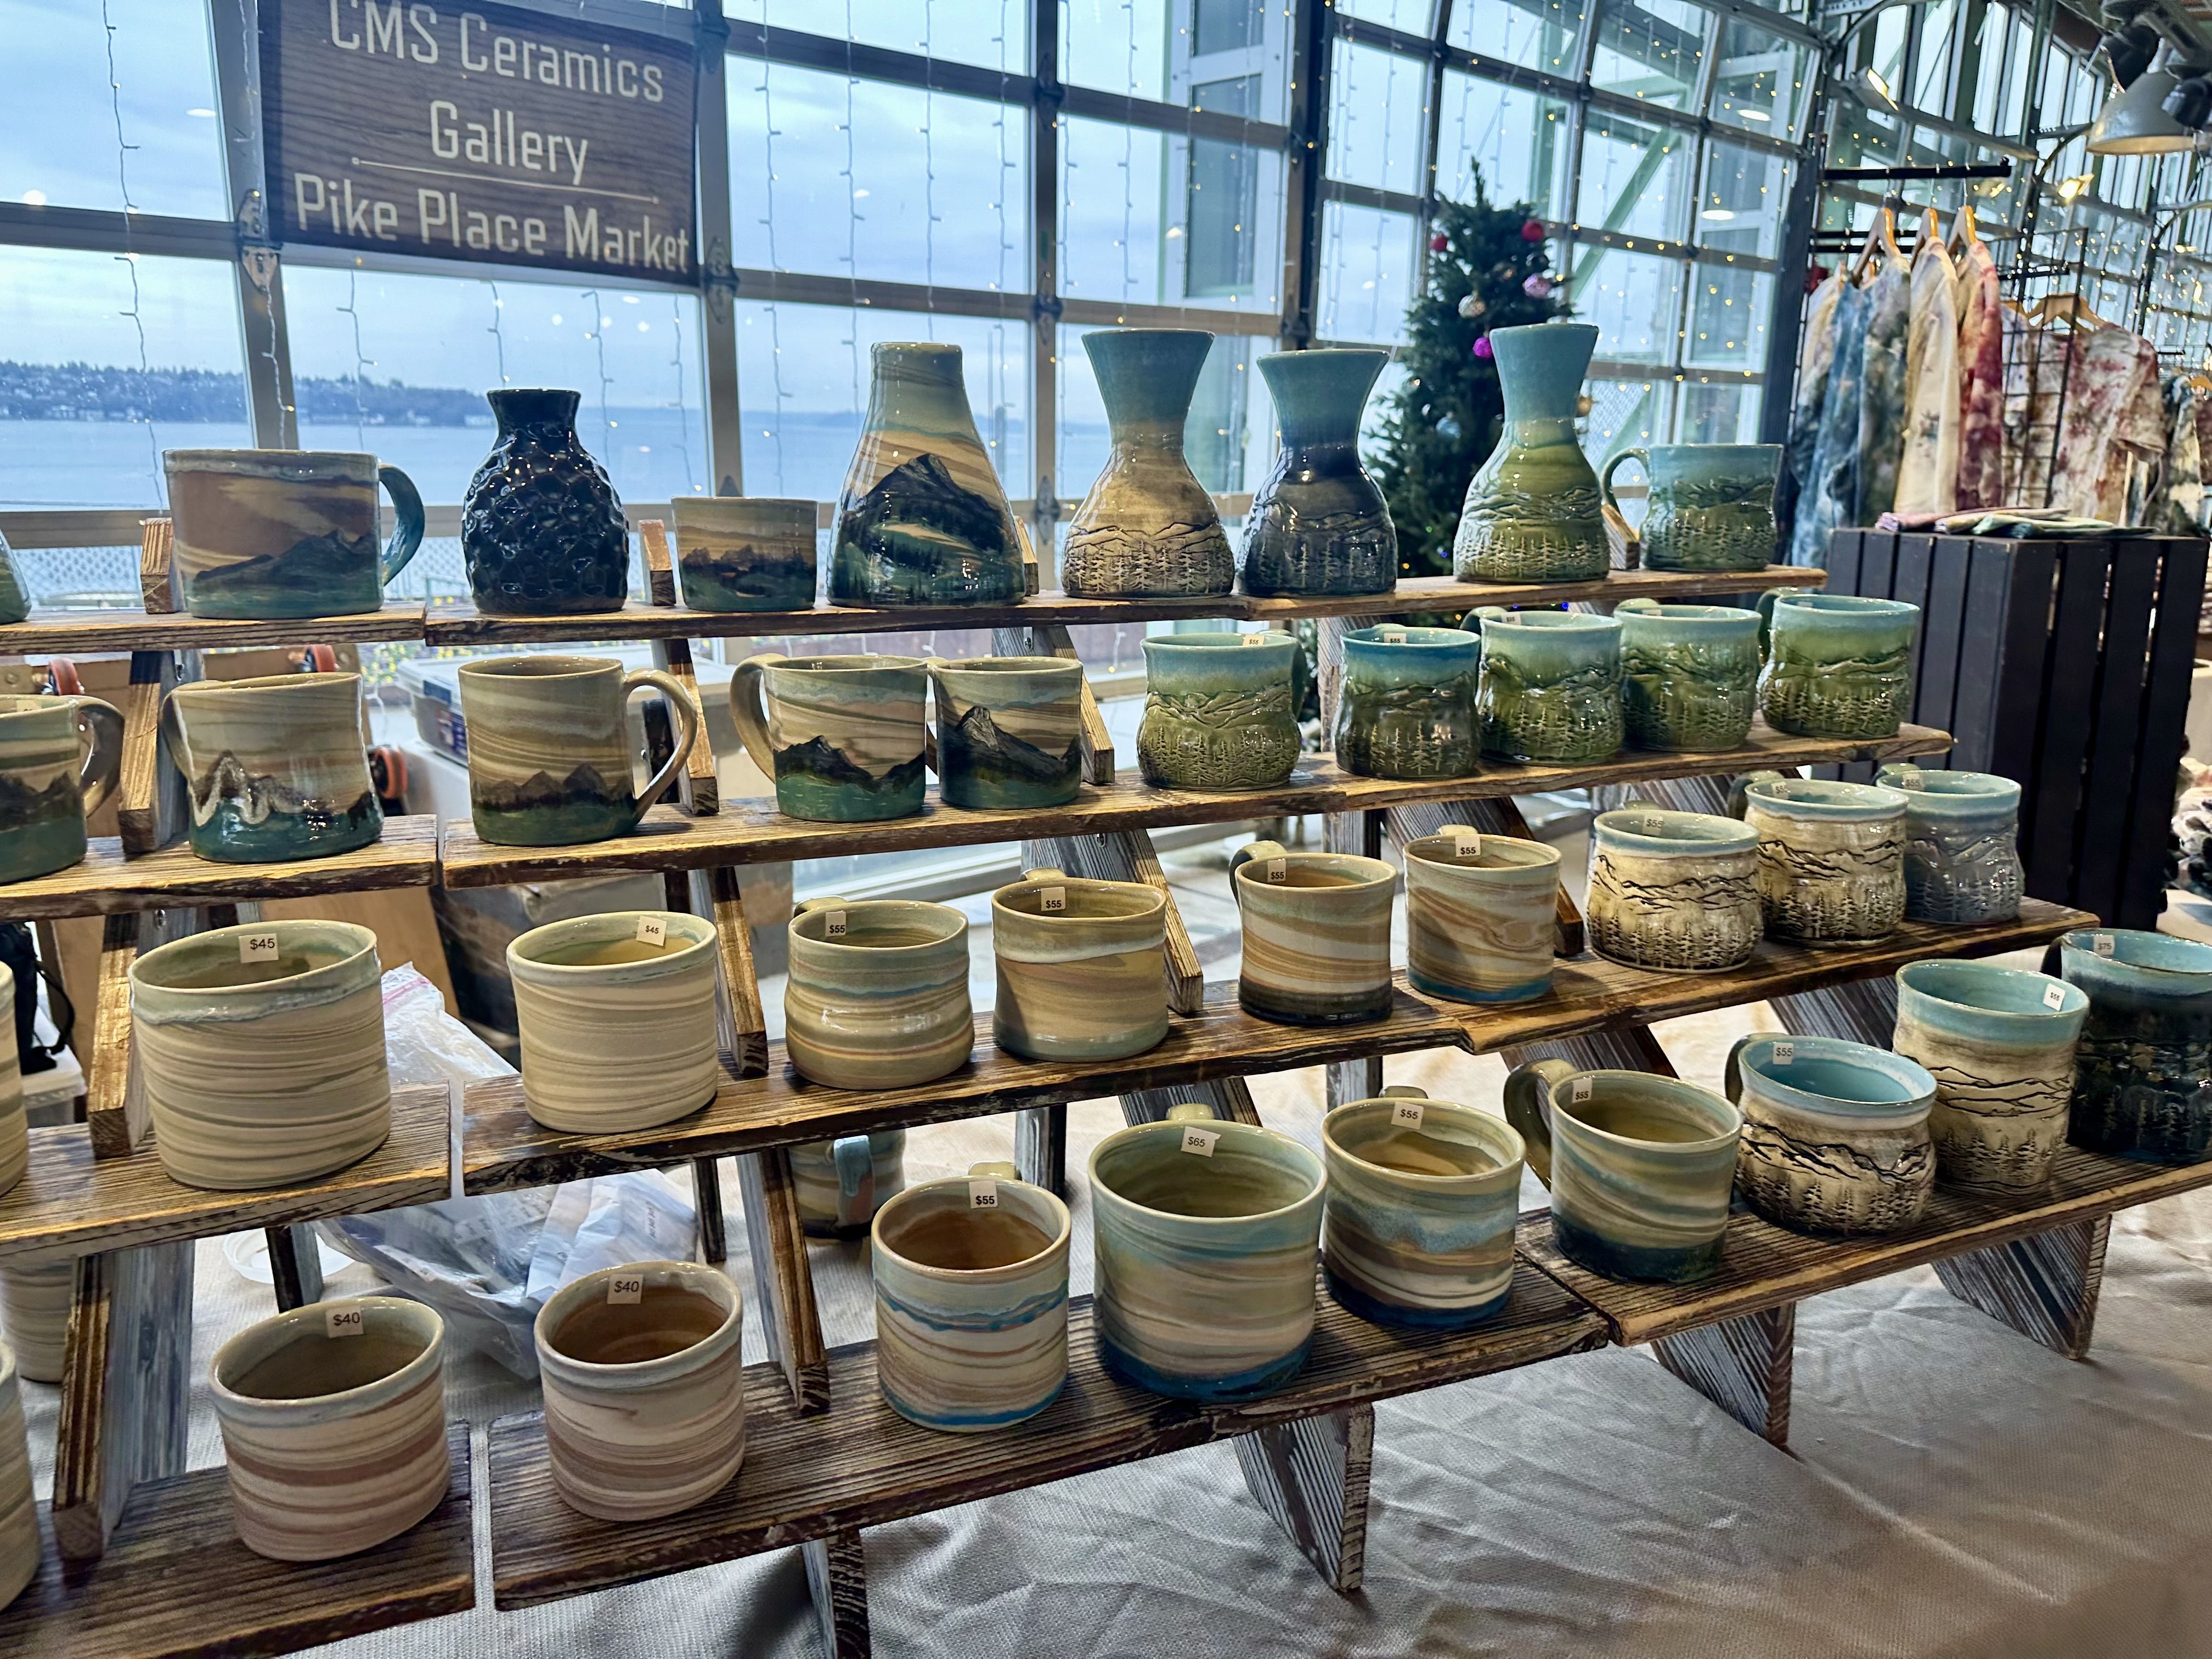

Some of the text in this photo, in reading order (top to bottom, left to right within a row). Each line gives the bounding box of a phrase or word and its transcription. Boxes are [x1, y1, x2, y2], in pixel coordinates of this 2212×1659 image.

[331, 0, 664, 103] CMS Ceramics
[430, 100, 588, 185] Gallery
[294, 173, 690, 273] Pike Place Market
[1646, 819, 1664, 828] $55
[1460, 847, 1476, 855] $55
[1271, 871, 1284, 880] $55
[1045, 900, 1062, 909] $55
[646, 925, 659, 934] $45
[830, 924, 845, 934] $55
[250, 938, 275, 951] $45
[2098, 943, 2112, 951] $75
[2050, 991, 2061, 1001] $55
[1776, 1047, 1793, 1057] $55
[1575, 1091, 1589, 1101] $55
[1400, 1109, 1419, 1120] $55
[1188, 1136, 1206, 1147] $65
[976, 1195, 995, 1205] $55
[614, 1280, 640, 1293] $40
[333, 1312, 360, 1326] $40
